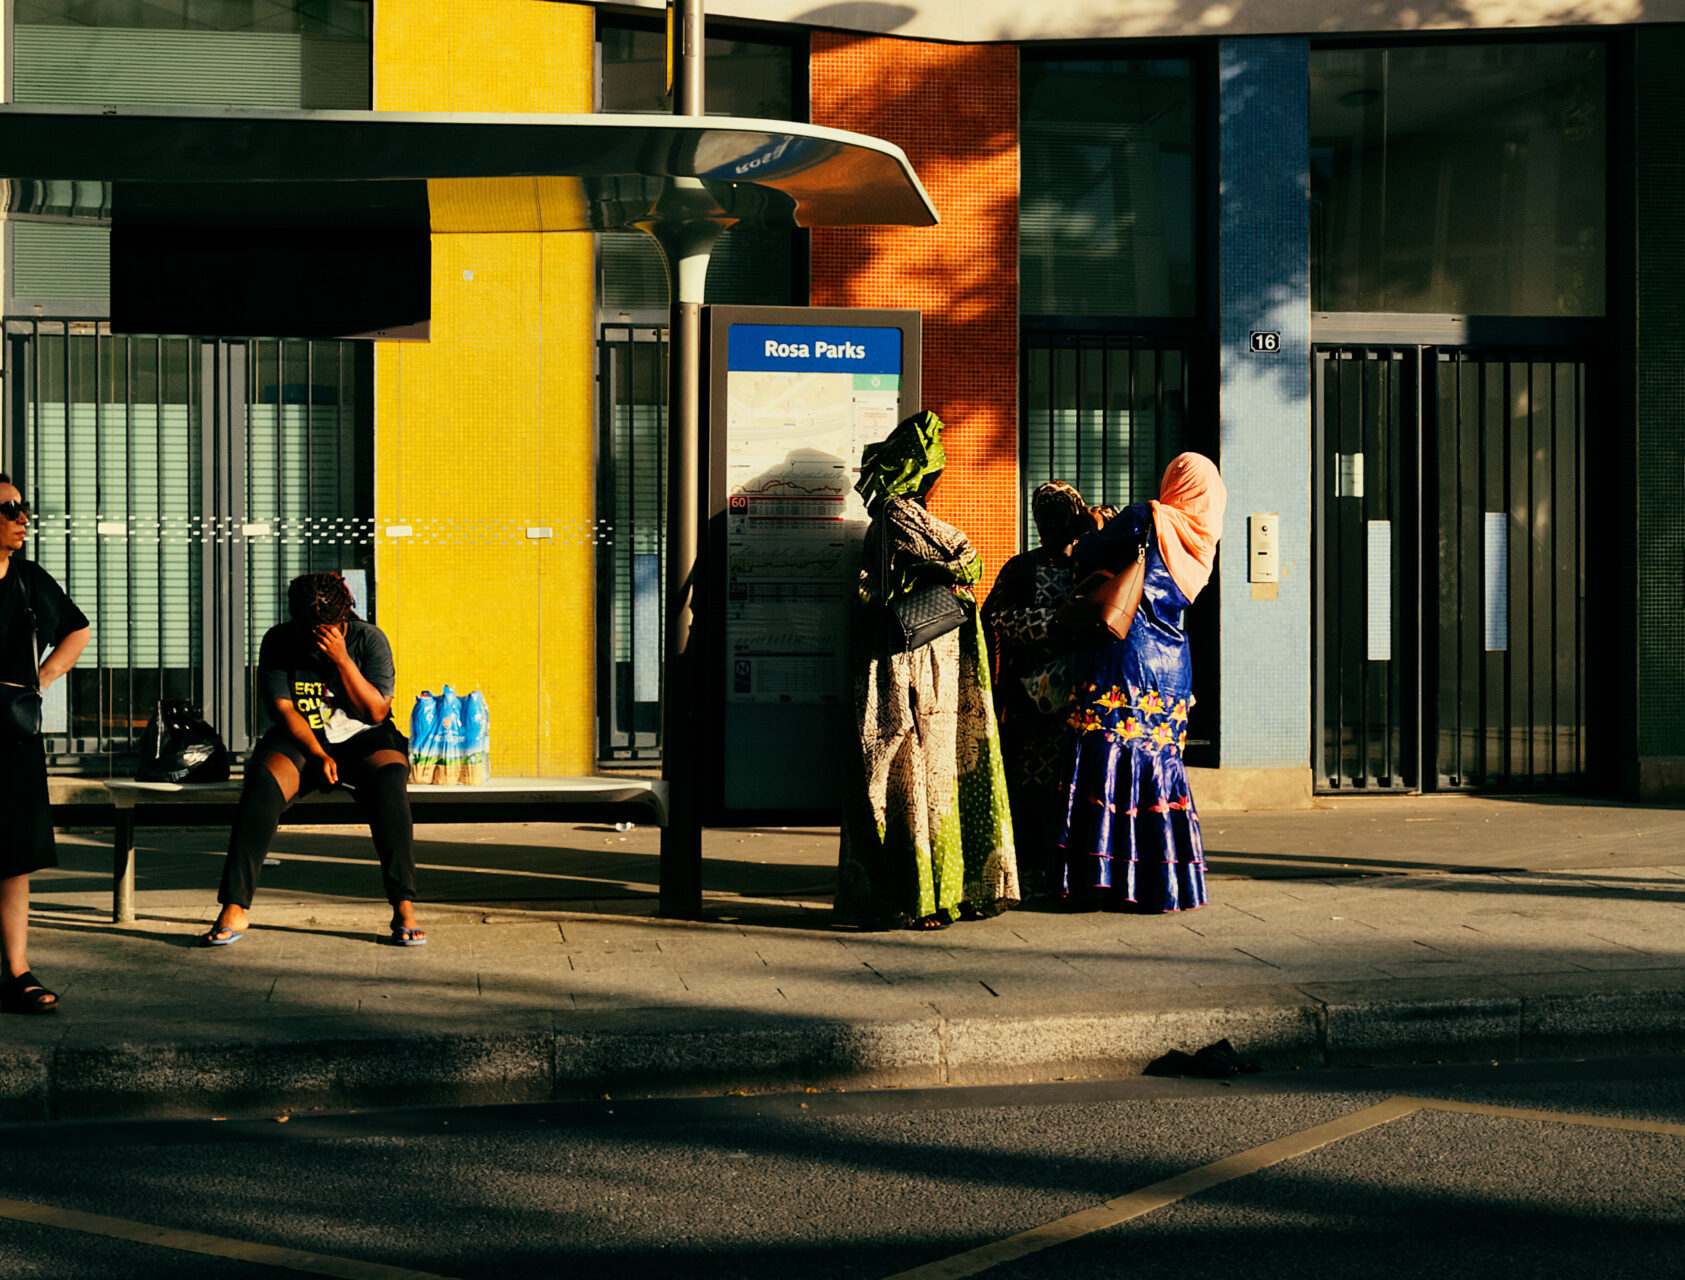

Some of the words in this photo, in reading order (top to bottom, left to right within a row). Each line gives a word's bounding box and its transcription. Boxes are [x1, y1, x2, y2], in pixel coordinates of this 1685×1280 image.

[765, 340, 809, 358] Rosa
[815, 341, 866, 360] Parks
[1256, 335, 1275, 350] 16
[731, 497, 746, 508] 60
